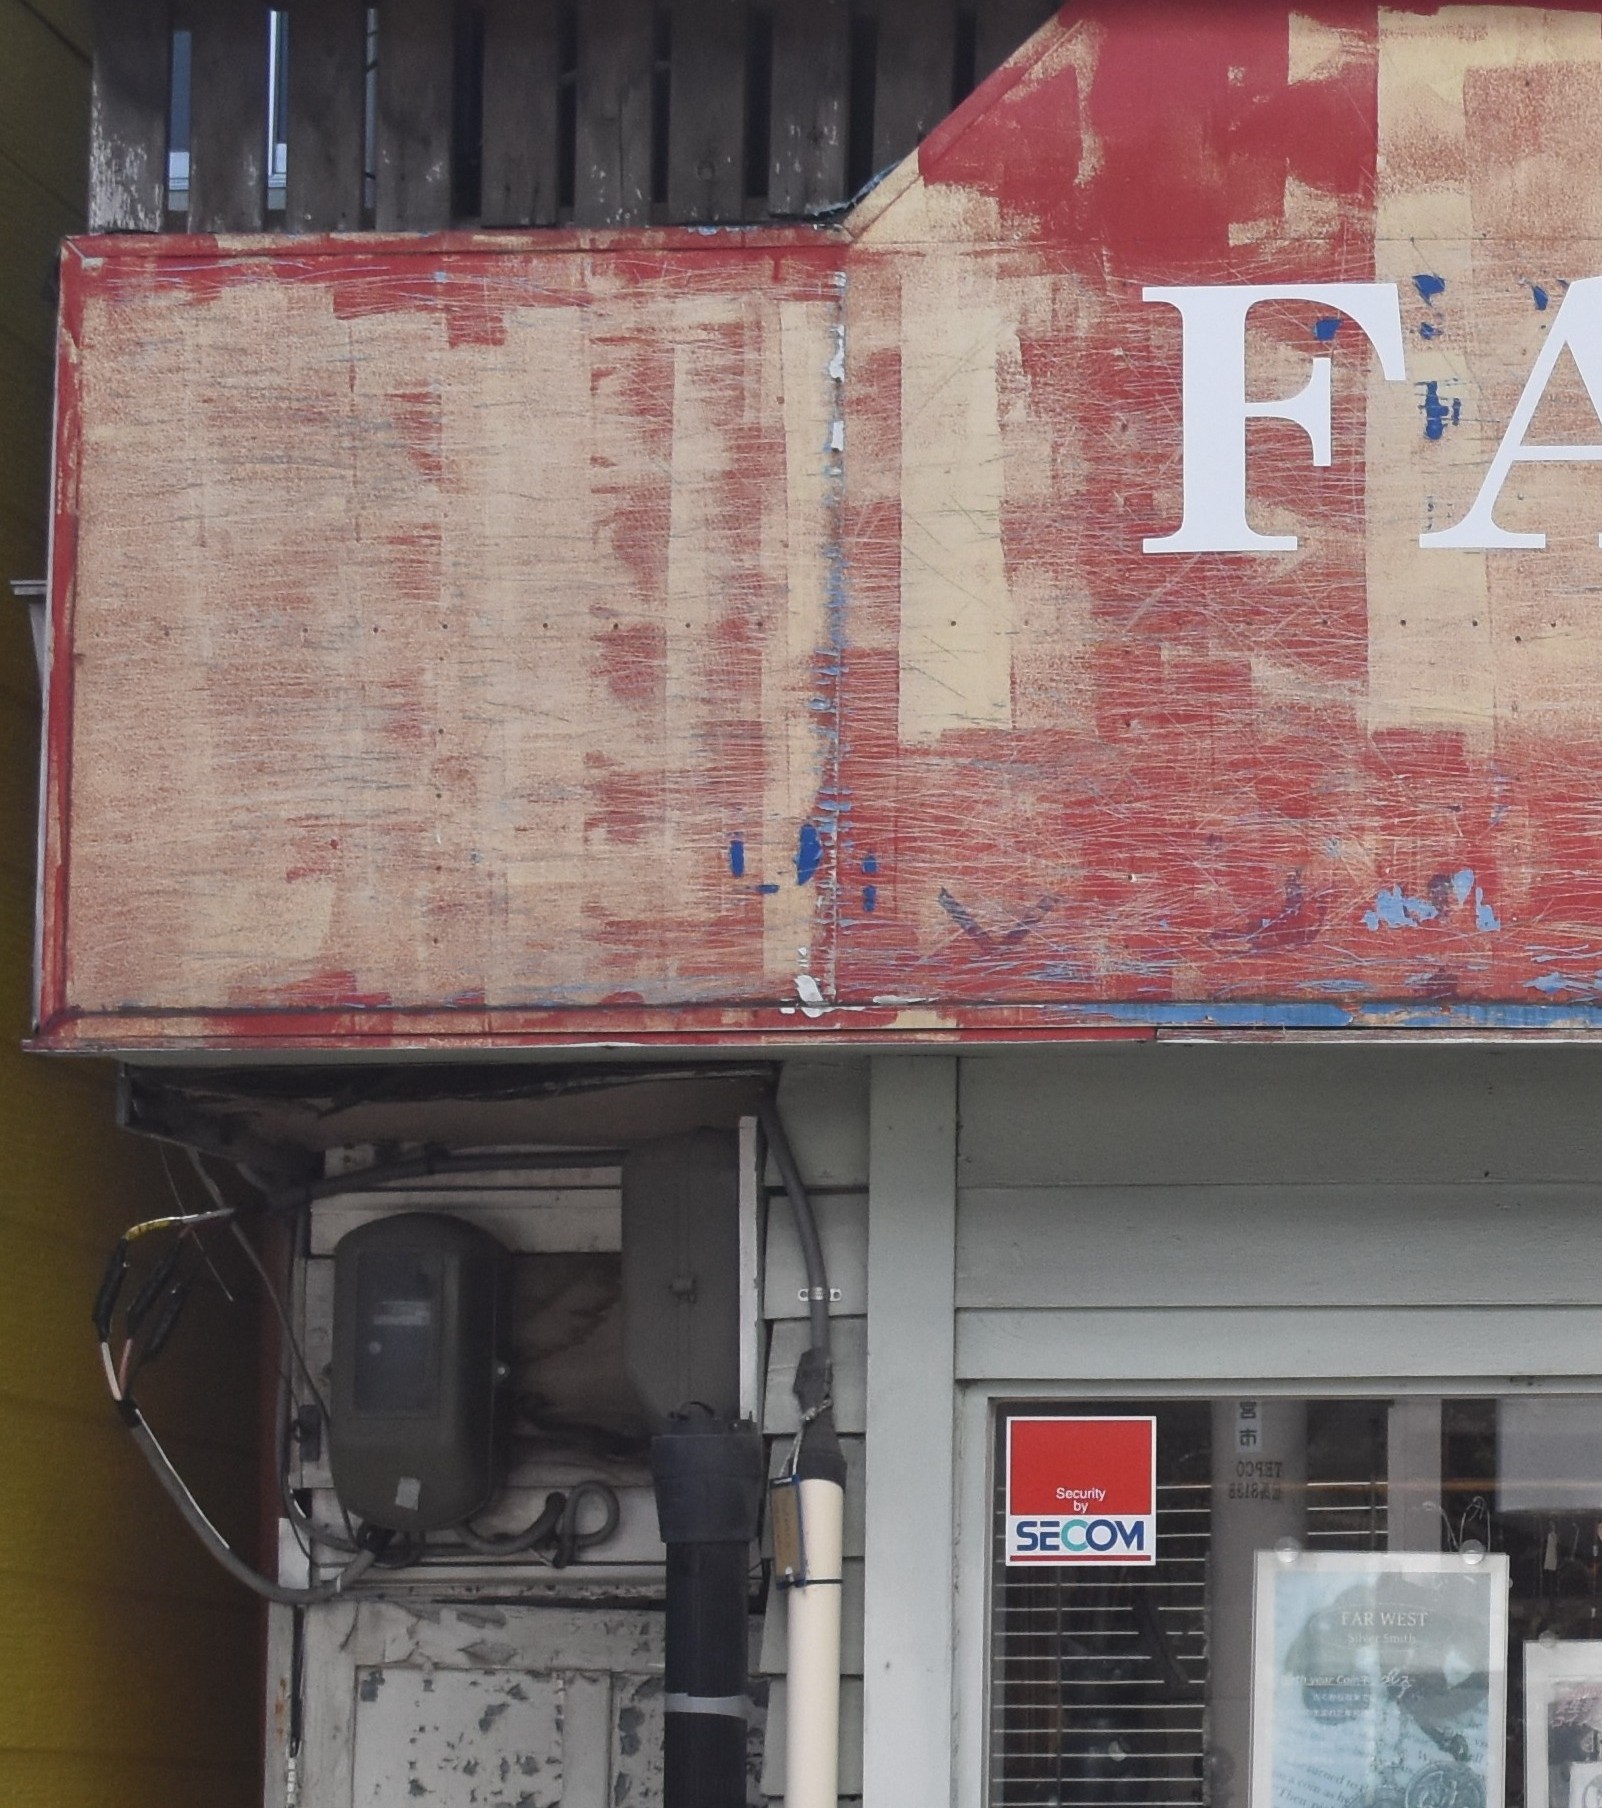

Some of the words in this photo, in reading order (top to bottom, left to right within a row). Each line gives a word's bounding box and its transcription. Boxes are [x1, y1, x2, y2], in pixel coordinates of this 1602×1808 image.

[1056, 1487, 1106, 1502] Security
[1073, 1500, 1089, 1514] by
[1016, 1519, 1144, 1552] SECOM
[1341, 1611, 1374, 1626] FAR
[1381, 1611, 1428, 1627] WEST
